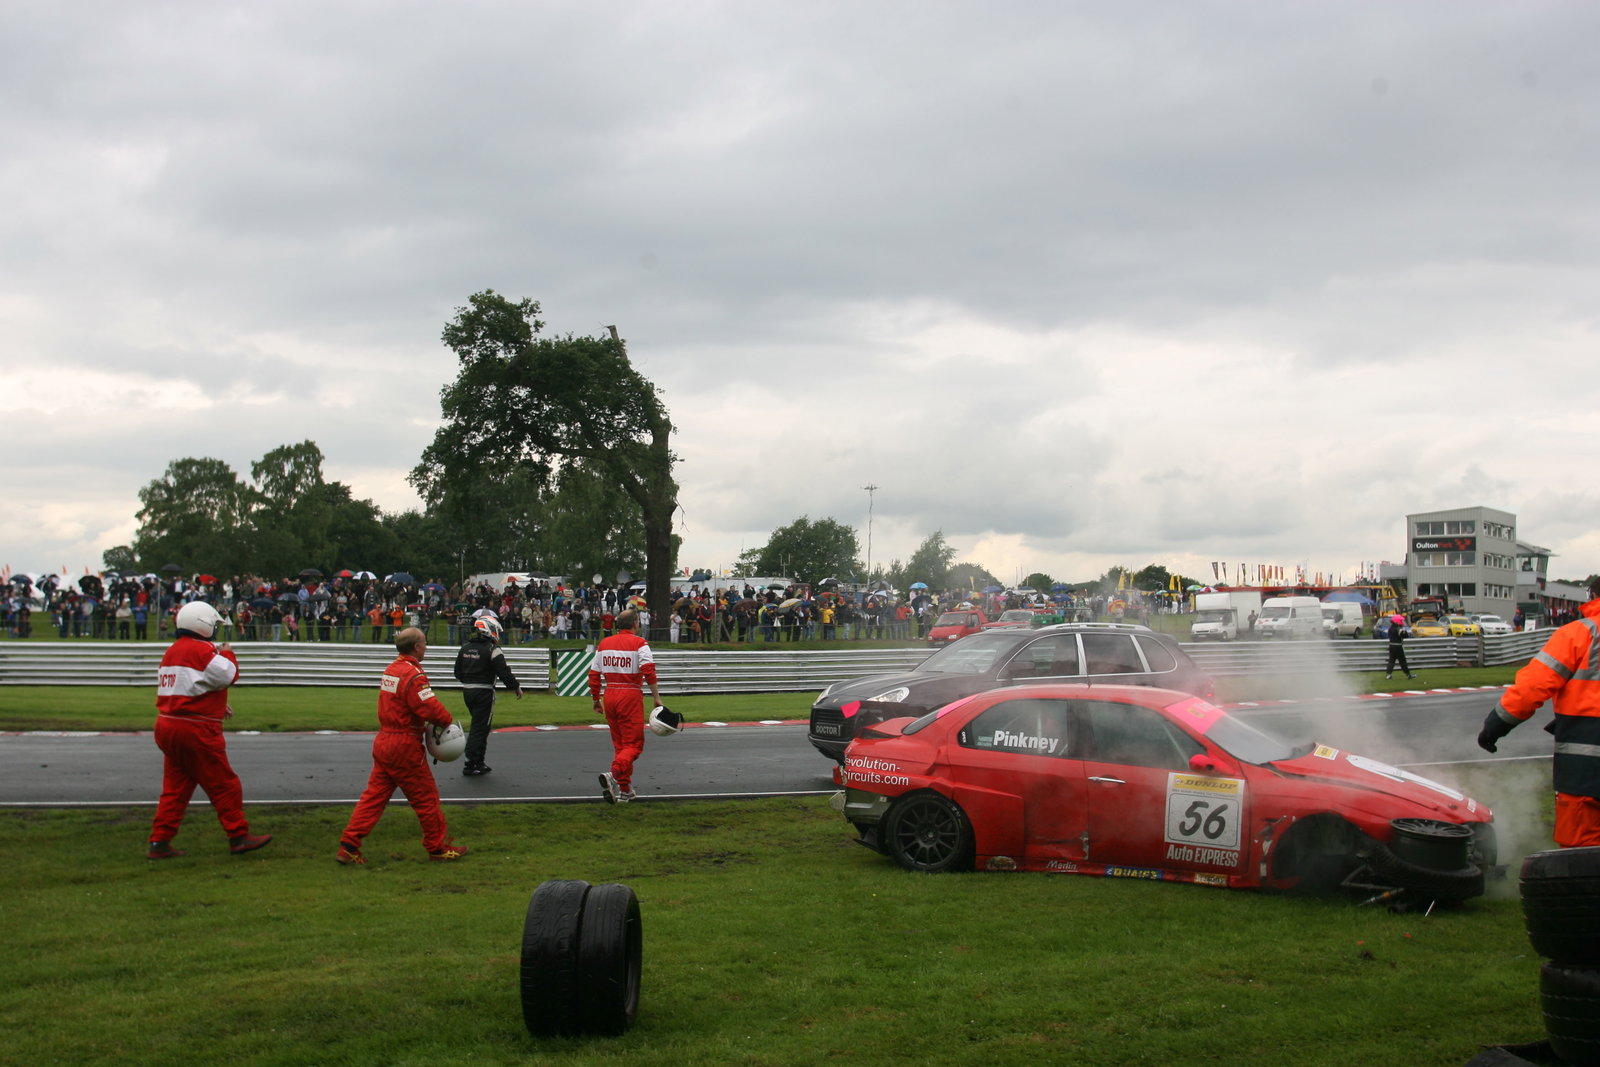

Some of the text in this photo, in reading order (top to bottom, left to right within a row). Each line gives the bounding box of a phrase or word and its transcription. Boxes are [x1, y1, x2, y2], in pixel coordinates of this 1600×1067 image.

[603, 656, 632, 668] DOCTOR
[816, 725, 837, 736] DOCTOR
[993, 730, 1059, 754] Pinkney
[1185, 779, 1238, 790] DUNLOP
[1178, 800, 1229, 840] 56
[1166, 844, 1239, 867] Auto EXPRESS
